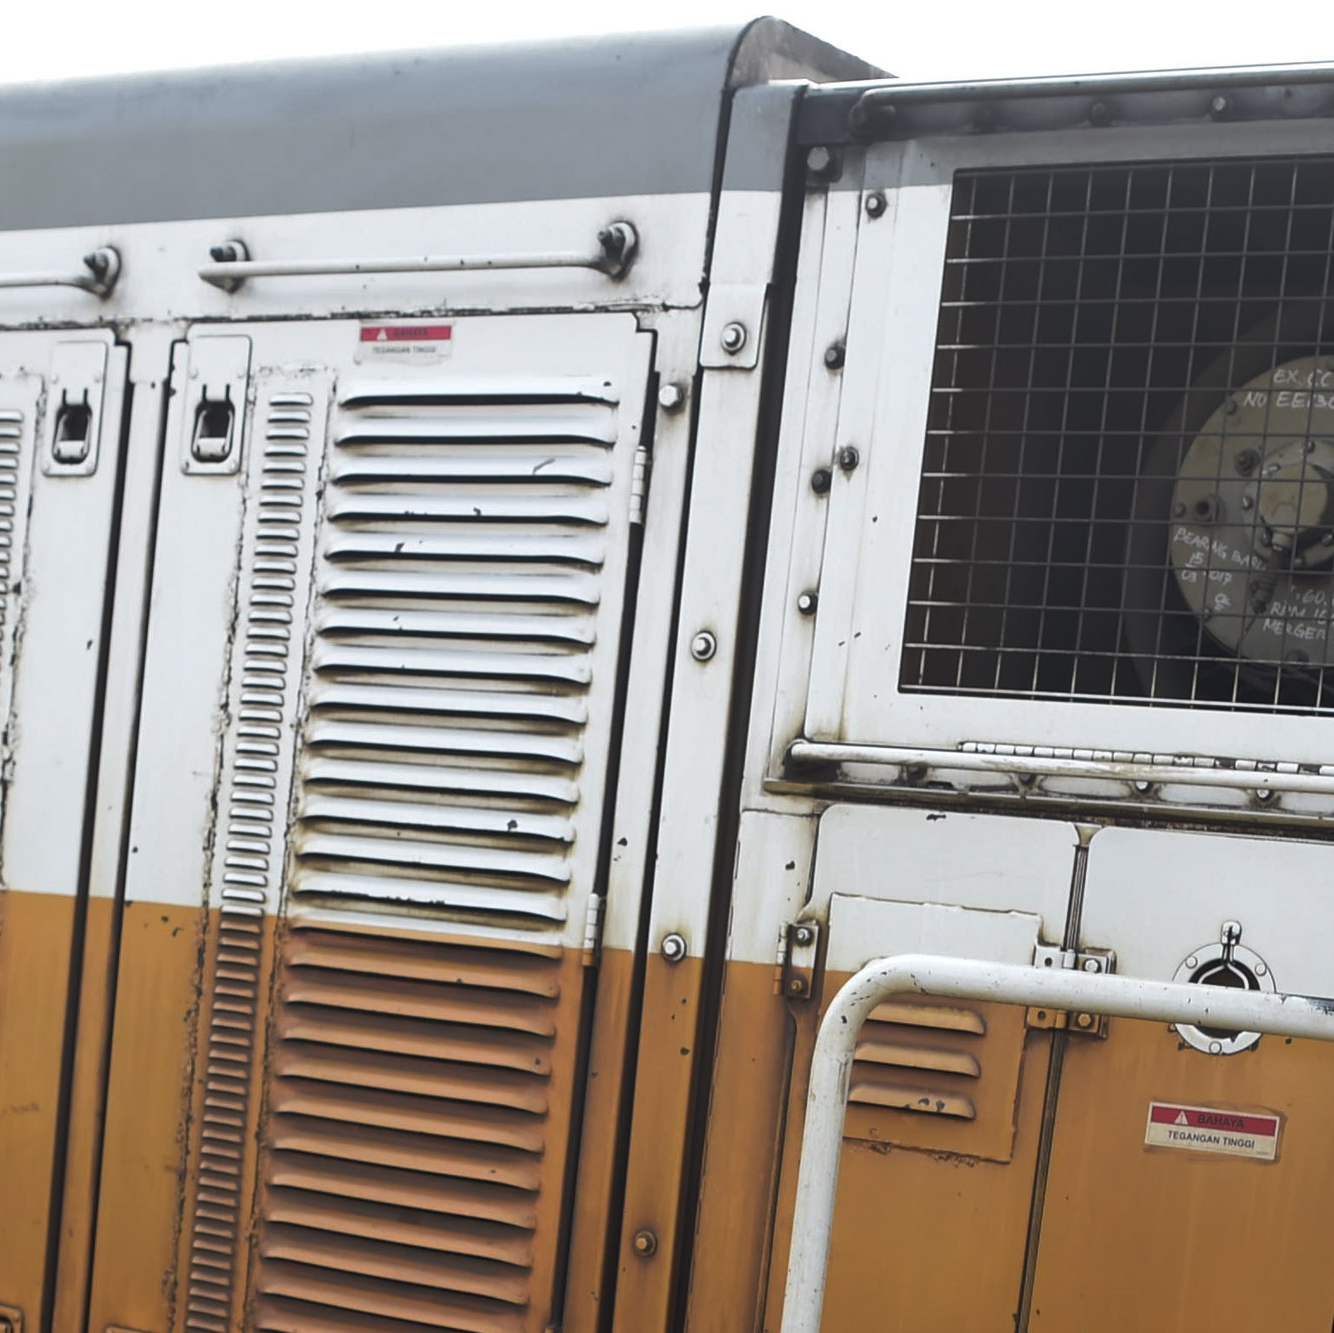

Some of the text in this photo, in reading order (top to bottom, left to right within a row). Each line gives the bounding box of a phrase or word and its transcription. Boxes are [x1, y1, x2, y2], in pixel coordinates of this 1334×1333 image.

[1173, 527, 1228, 560] BEARNG
[1197, 1113, 1245, 1129] BAHAYA
[1167, 1130, 1255, 1149] TEGANGAN TINGGI
